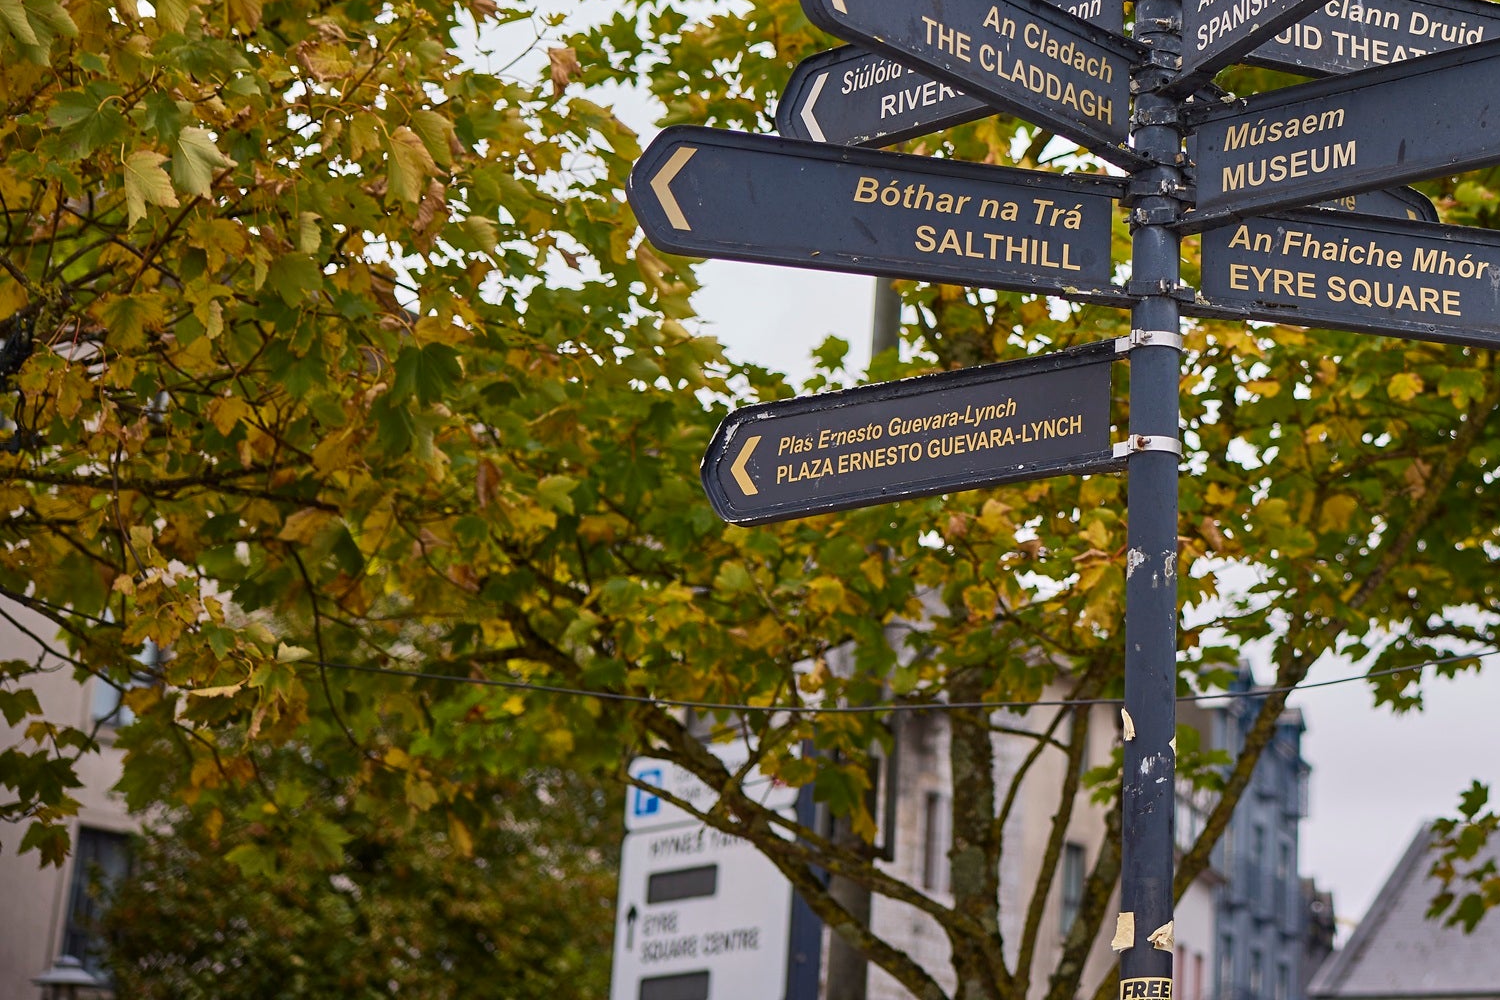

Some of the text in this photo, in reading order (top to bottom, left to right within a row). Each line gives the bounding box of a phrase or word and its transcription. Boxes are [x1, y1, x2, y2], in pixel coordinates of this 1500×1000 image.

[983, 6, 1113, 83] An Cladach
[1409, 11, 1484, 45] Druid
[921, 16, 1113, 125] THE CLADDAGH
[880, 80, 965, 119] RIVER
[1224, 107, 1345, 152] Músaem
[1222, 140, 1357, 192] MUSEUM
[853, 176, 1082, 230] Bóthar na Trá
[915, 226, 1081, 271] SALTHILL
[1229, 224, 1489, 279] An Fhaiche Mhór
[1230, 264, 1462, 317] EYRE SQUARE
[776, 415, 1082, 484] PLAZA ERNESTO GUEVARA-LYNCH
[778, 397, 1017, 457] Plas Ernesto Guevara-Lynch
[641, 927, 759, 963] SQUARE CENTRE
